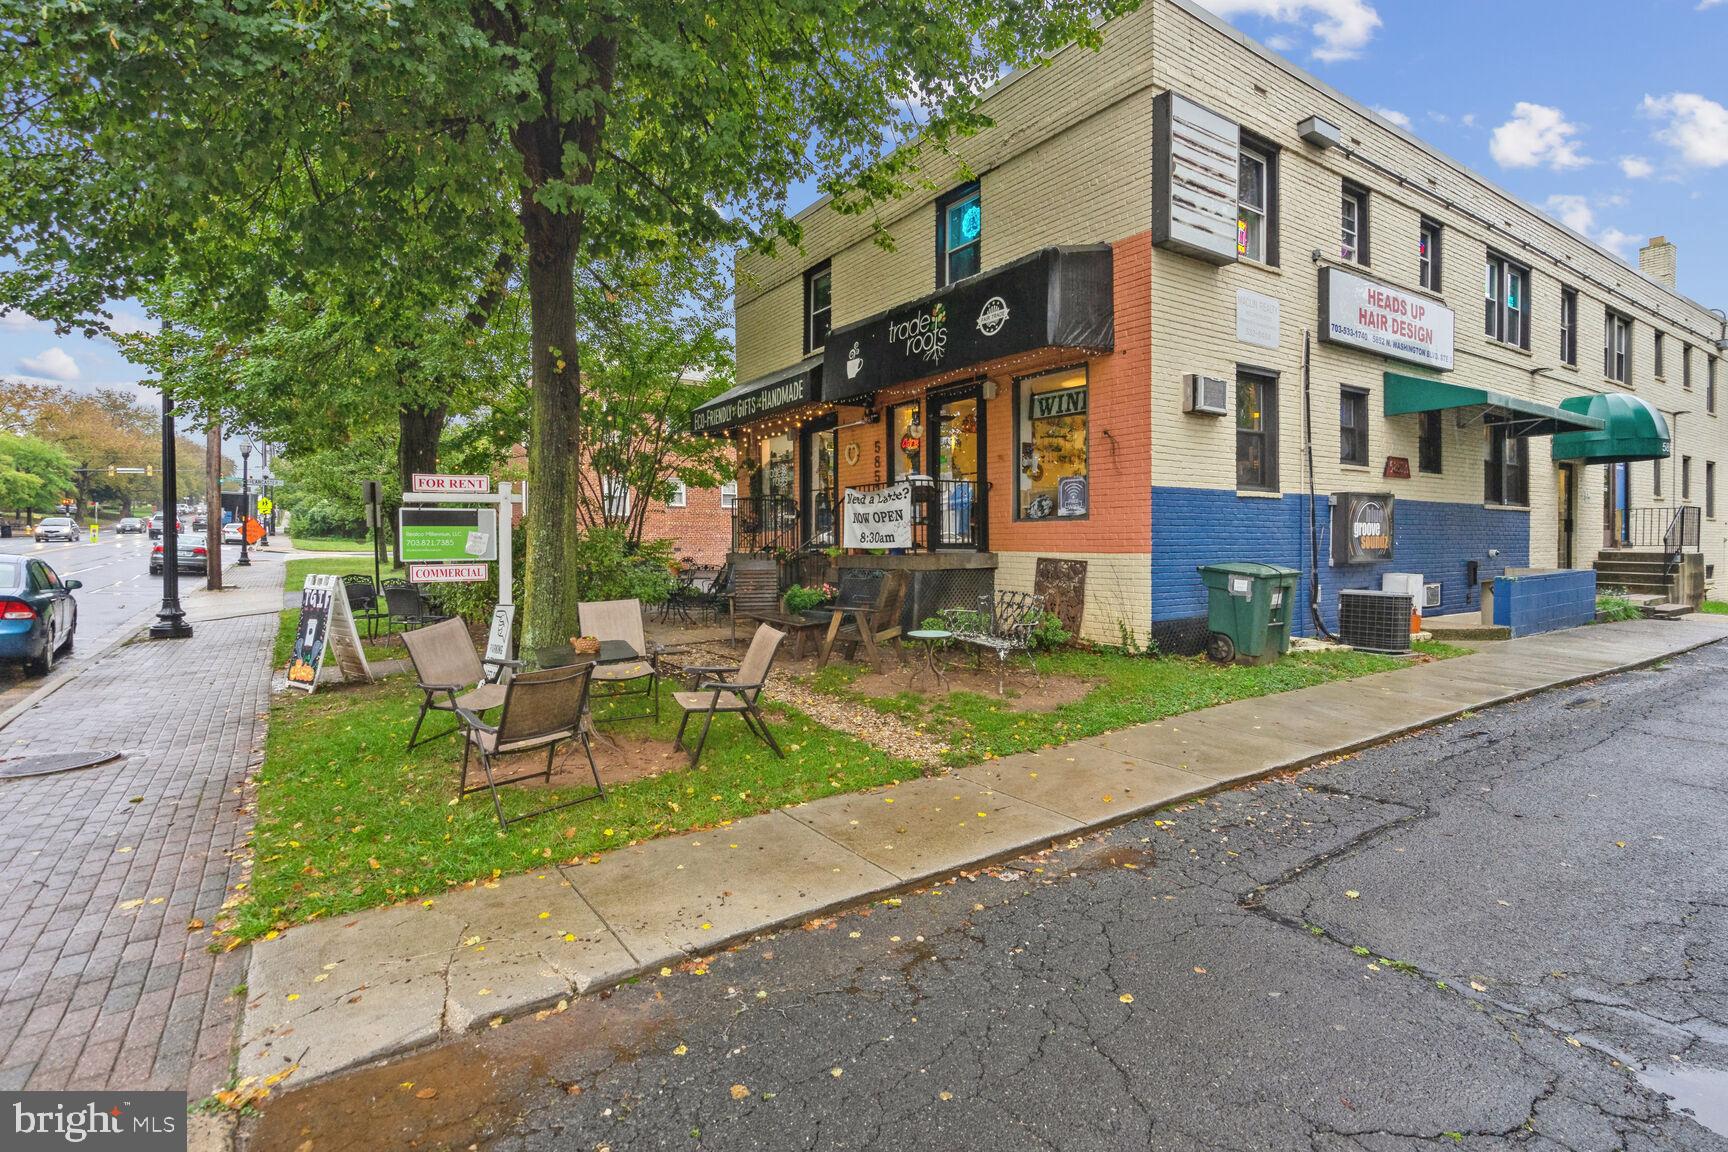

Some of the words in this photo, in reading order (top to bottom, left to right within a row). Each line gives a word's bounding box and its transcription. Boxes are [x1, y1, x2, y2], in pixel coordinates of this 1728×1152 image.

[1367, 288, 1407, 316] HEADS
[1410, 303, 1425, 321] UP
[888, 310, 931, 343] trade
[1359, 307, 1388, 332] HAIR
[1391, 317, 1433, 345] DESIGN
[906, 326, 948, 358] roots
[1392, 341, 1426, 357] WASHINGTON
[737, 396, 756, 418] GIFTS
[761, 379, 804, 411] HANDMADE
[1038, 391, 1087, 416] WIN
[418, 479, 445, 489] FOR
[449, 479, 484, 489] RENT
[847, 493, 867, 505] Need
[868, 496, 874, 504] a
[877, 487, 910, 504] Latte?
[852, 512, 870, 524] NOW
[872, 509, 904, 524] OPEN
[859, 532, 895, 544] 8:30am
[1353, 522, 1380, 537] groove
[415, 568, 484, 578] COMMERCIAL
